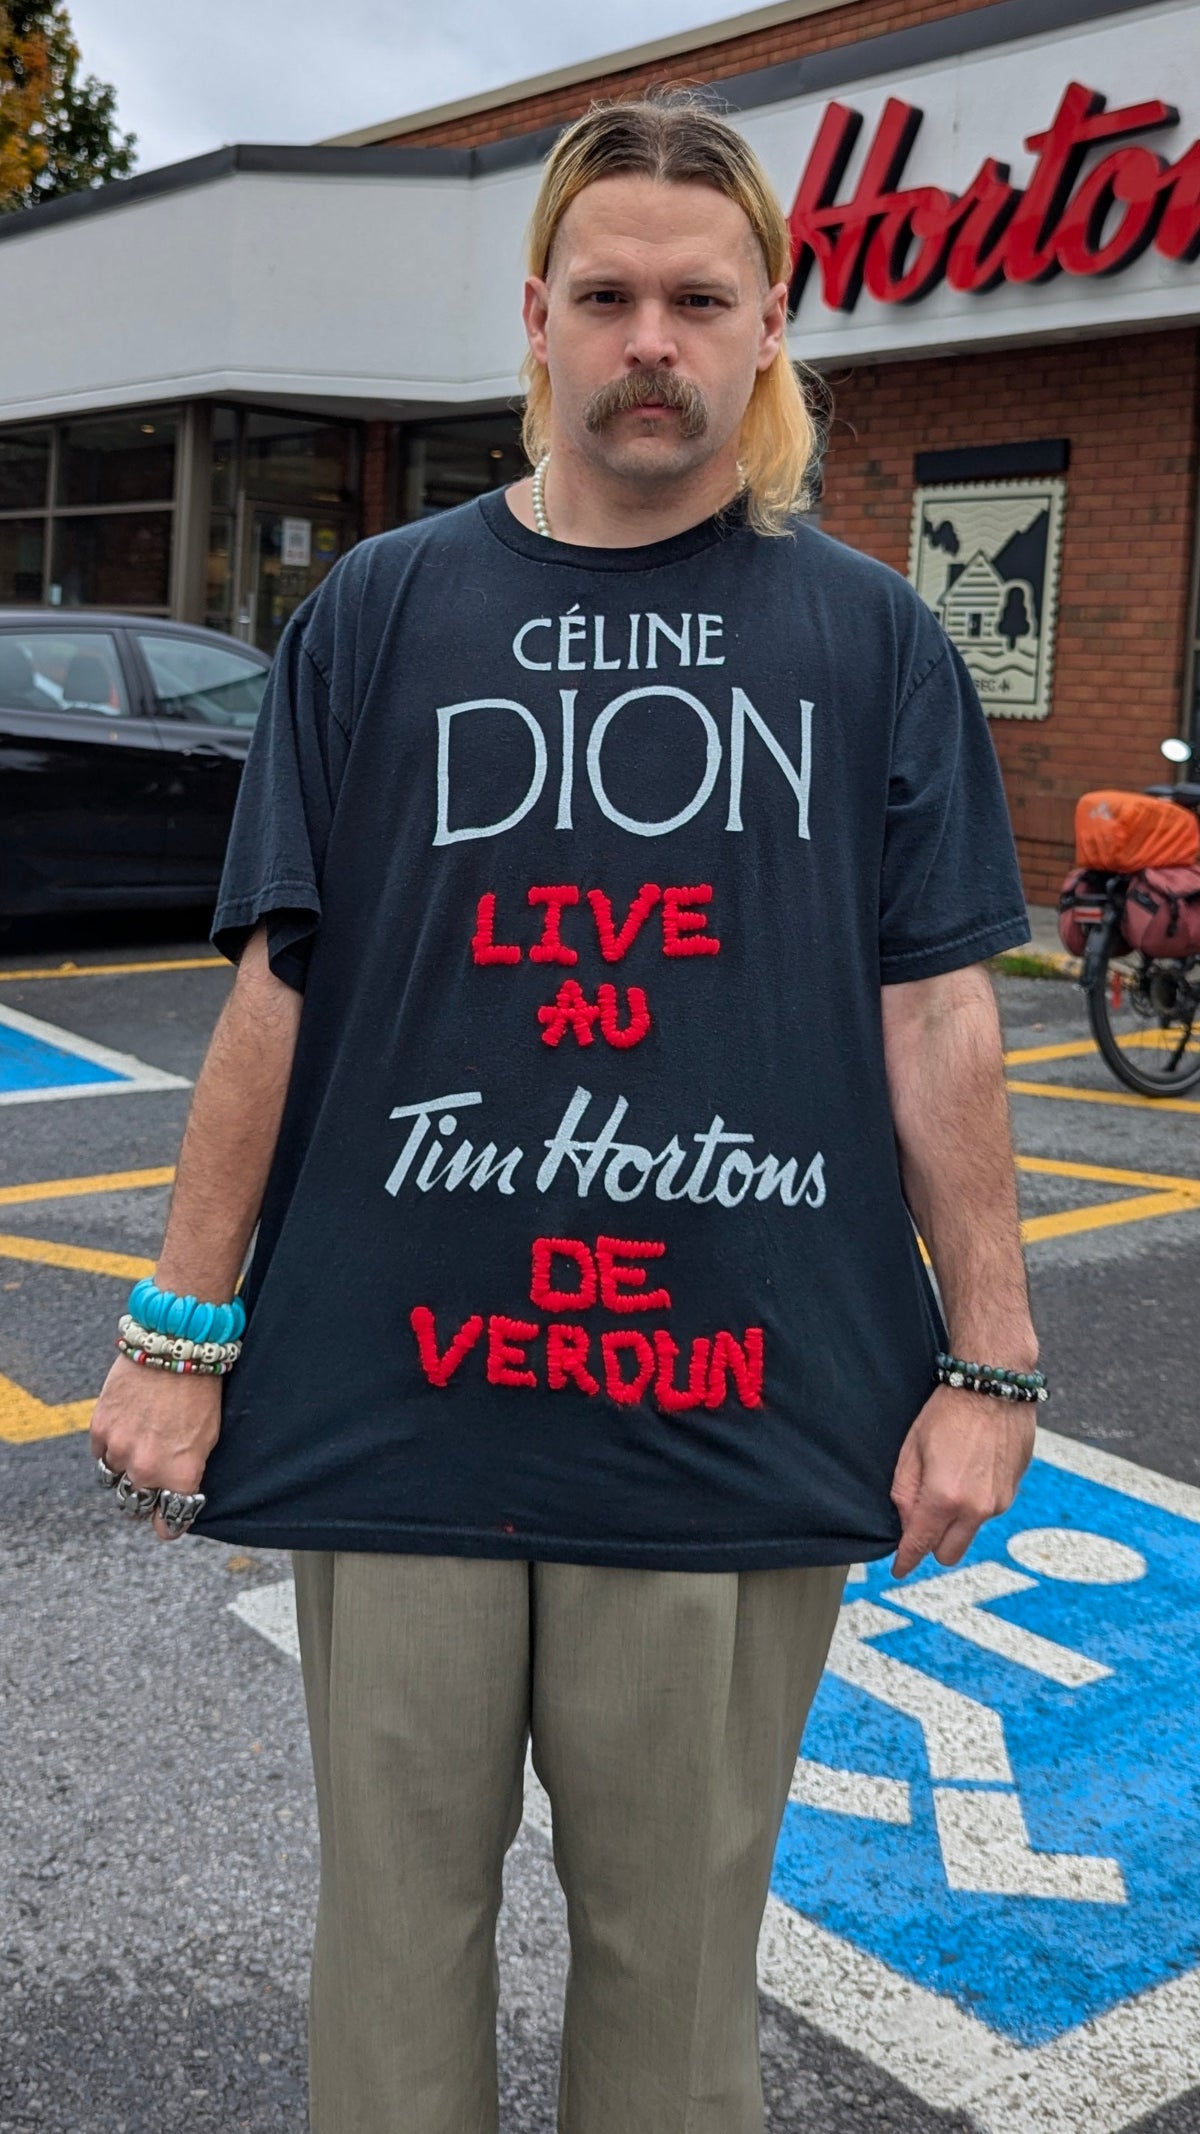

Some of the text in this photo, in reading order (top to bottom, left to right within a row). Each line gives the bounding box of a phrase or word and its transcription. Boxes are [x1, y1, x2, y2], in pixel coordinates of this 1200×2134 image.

[513, 604, 726, 671] CÉLINE
[431, 685, 815, 847] DION
[471, 883, 721, 966] LIVE
[537, 979, 652, 1049] AU
[384, 1085, 827, 1209] Tim Hortons
[529, 1235, 672, 1313] DE
[410, 1306, 764, 1412] VERDUN
